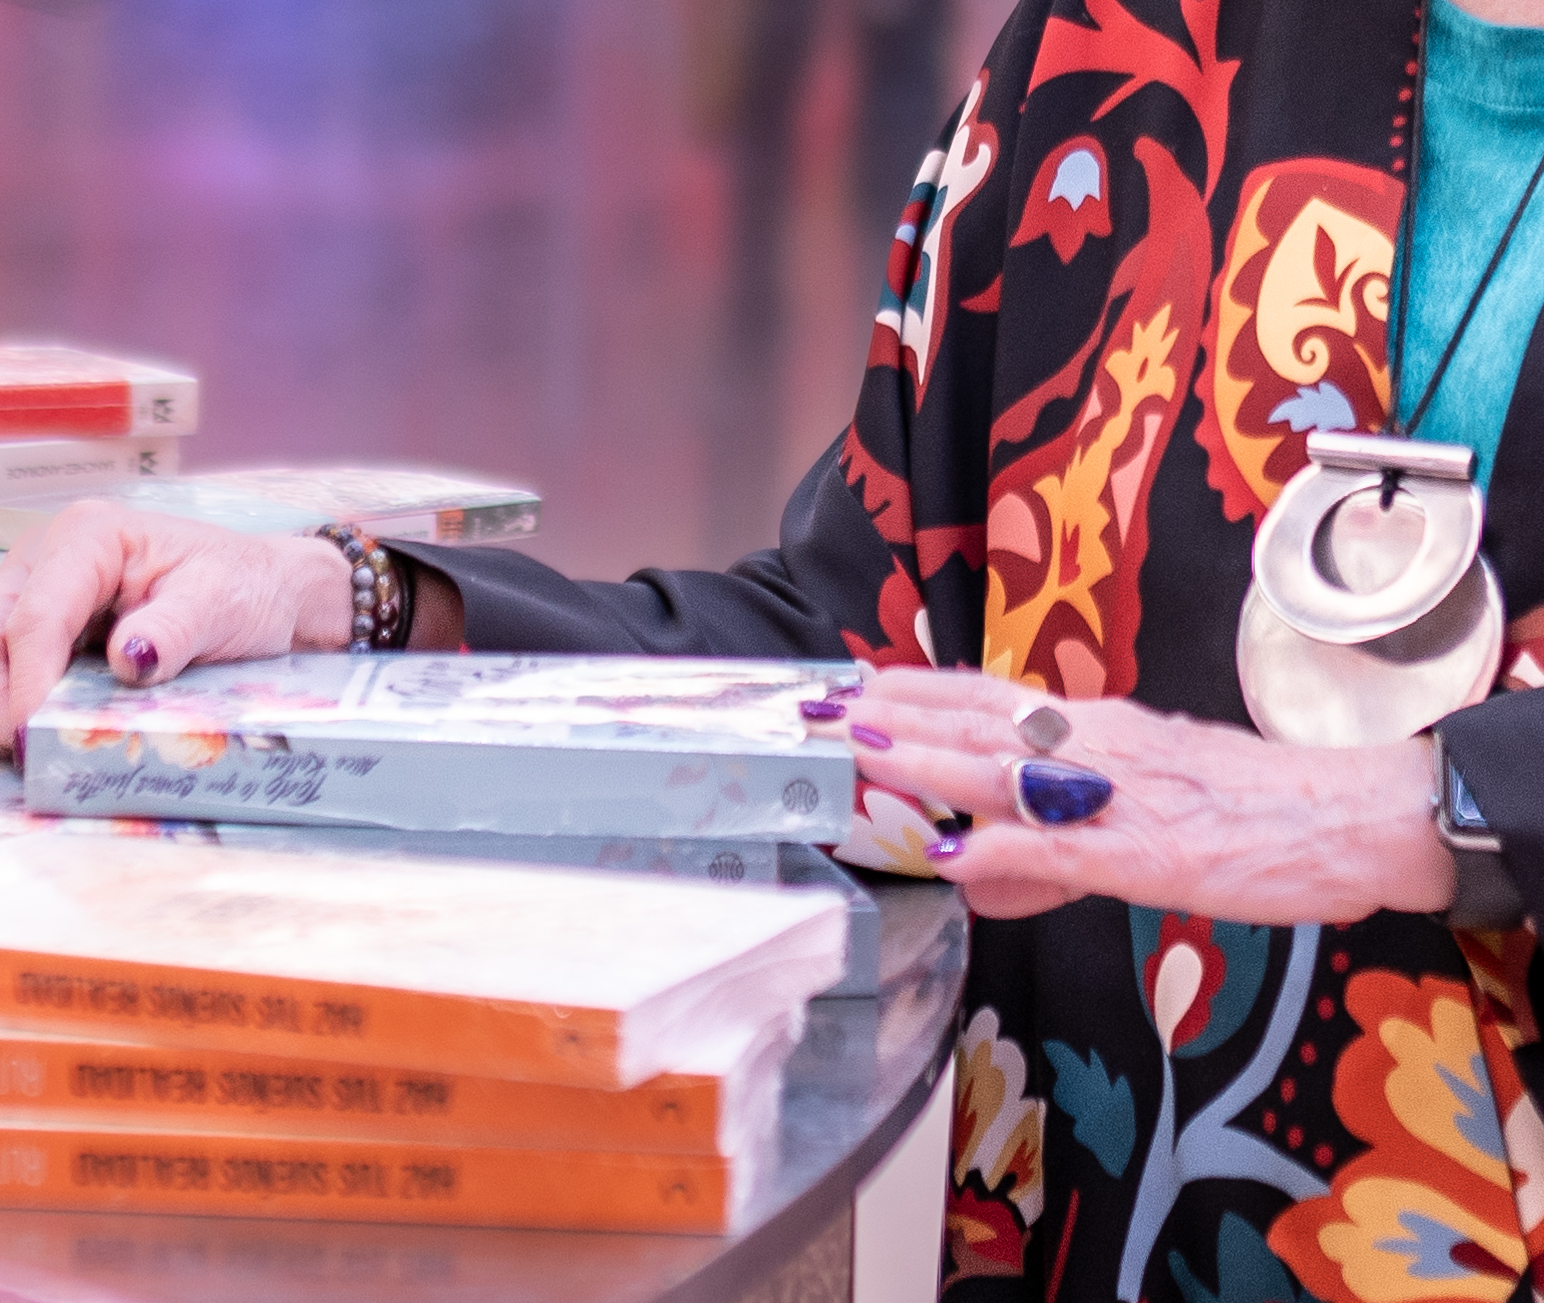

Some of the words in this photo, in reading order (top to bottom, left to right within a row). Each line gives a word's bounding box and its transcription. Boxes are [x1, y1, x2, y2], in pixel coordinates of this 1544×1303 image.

[262, 751, 327, 780] Kellen
[334, 752, 384, 778] Alice
[263, 771, 327, 806] Todo
[17, 971, 140, 1017] REALIDAD
[151, 982, 246, 1028] SUEÑOS
[260, 992, 303, 1034] TUS
[75, 1063, 207, 1106] REALIDAD
[217, 1067, 324, 1114] SUEÑOS
[332, 1072, 384, 1114] TUS
[76, 1151, 211, 1193] REALIDAD
[219, 1154, 328, 1197] SUEÑOS
[338, 1158, 386, 1198] TUS
